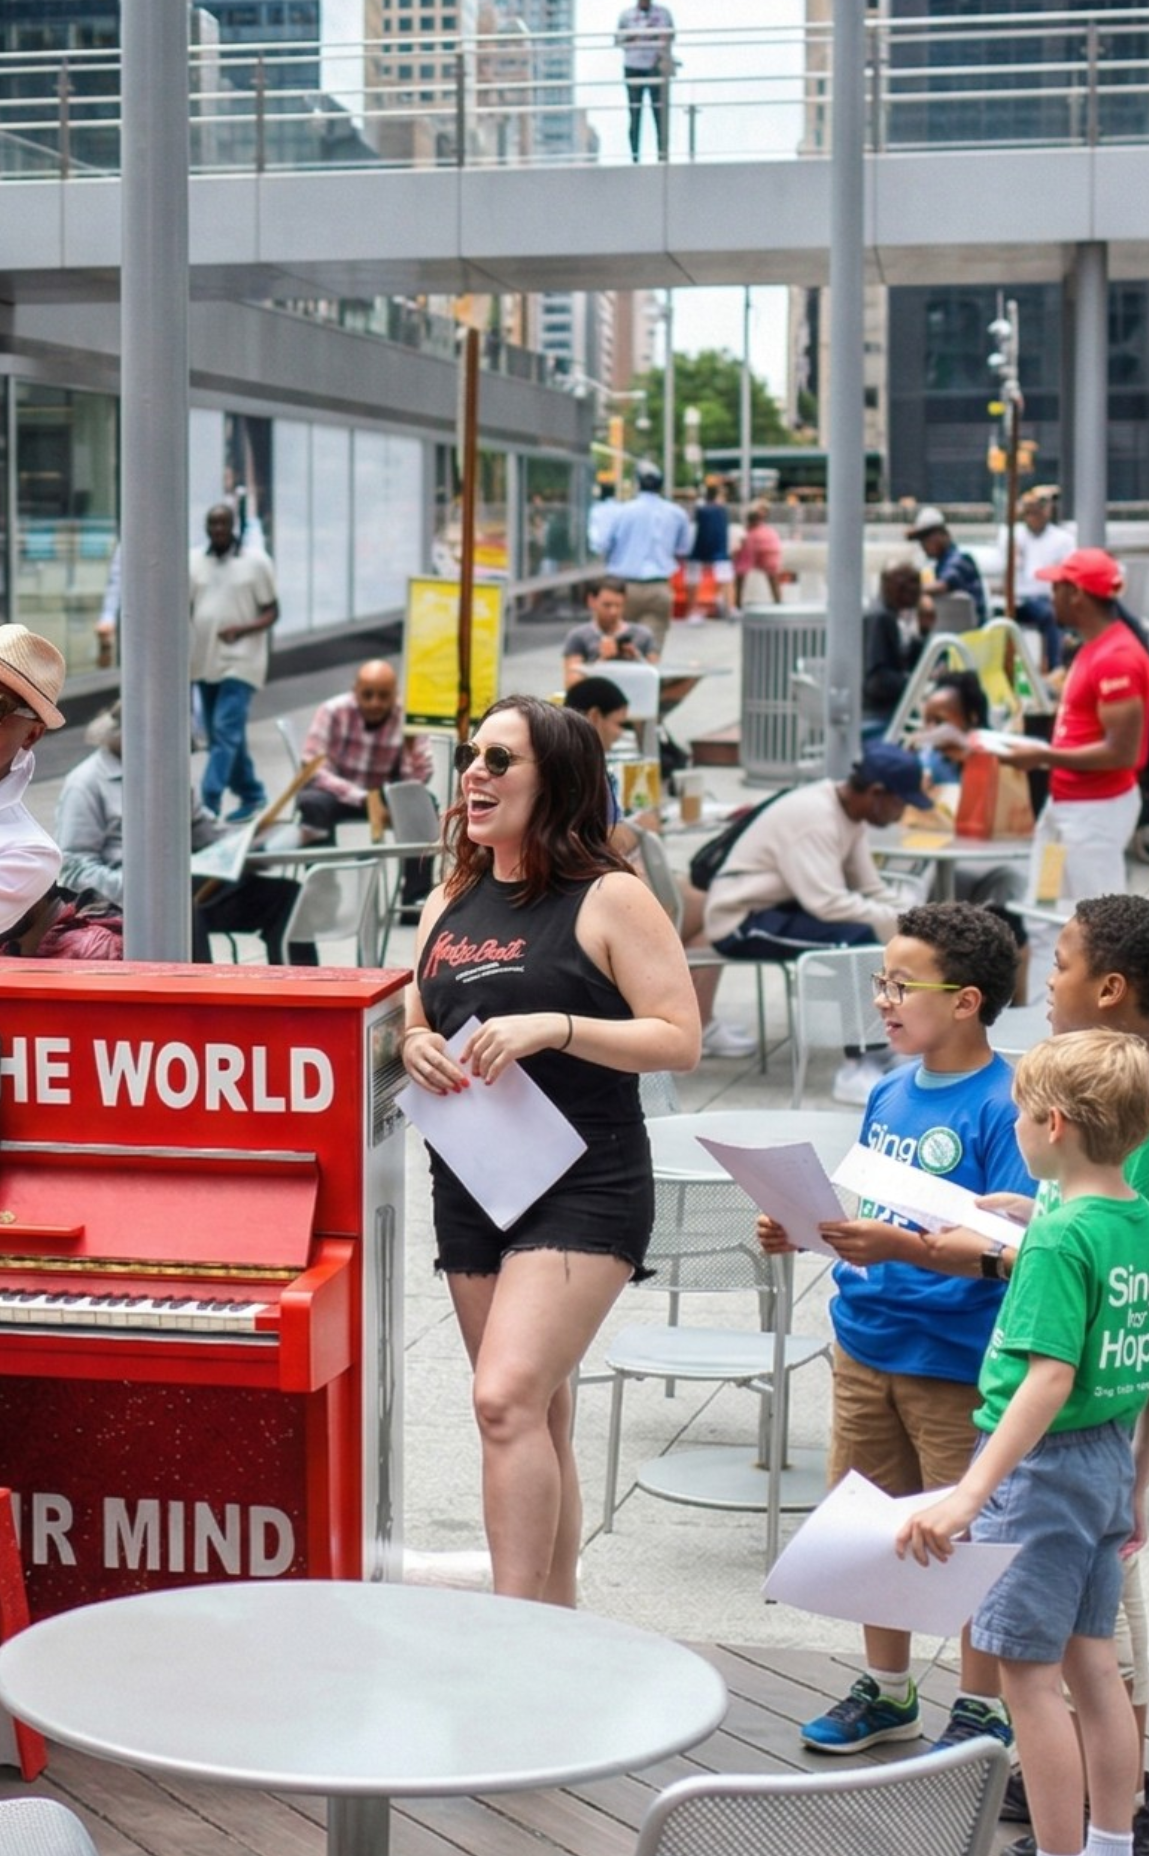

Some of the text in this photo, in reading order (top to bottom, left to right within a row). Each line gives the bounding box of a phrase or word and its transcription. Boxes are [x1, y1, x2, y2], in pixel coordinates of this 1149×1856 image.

[0, 1036, 71, 1105] HE
[93, 1039, 335, 1113] WORLD
[1108, 1265, 1149, 1308] Sin
[1098, 1328, 1149, 1373] Hop
[103, 1497, 296, 1578] MIND
